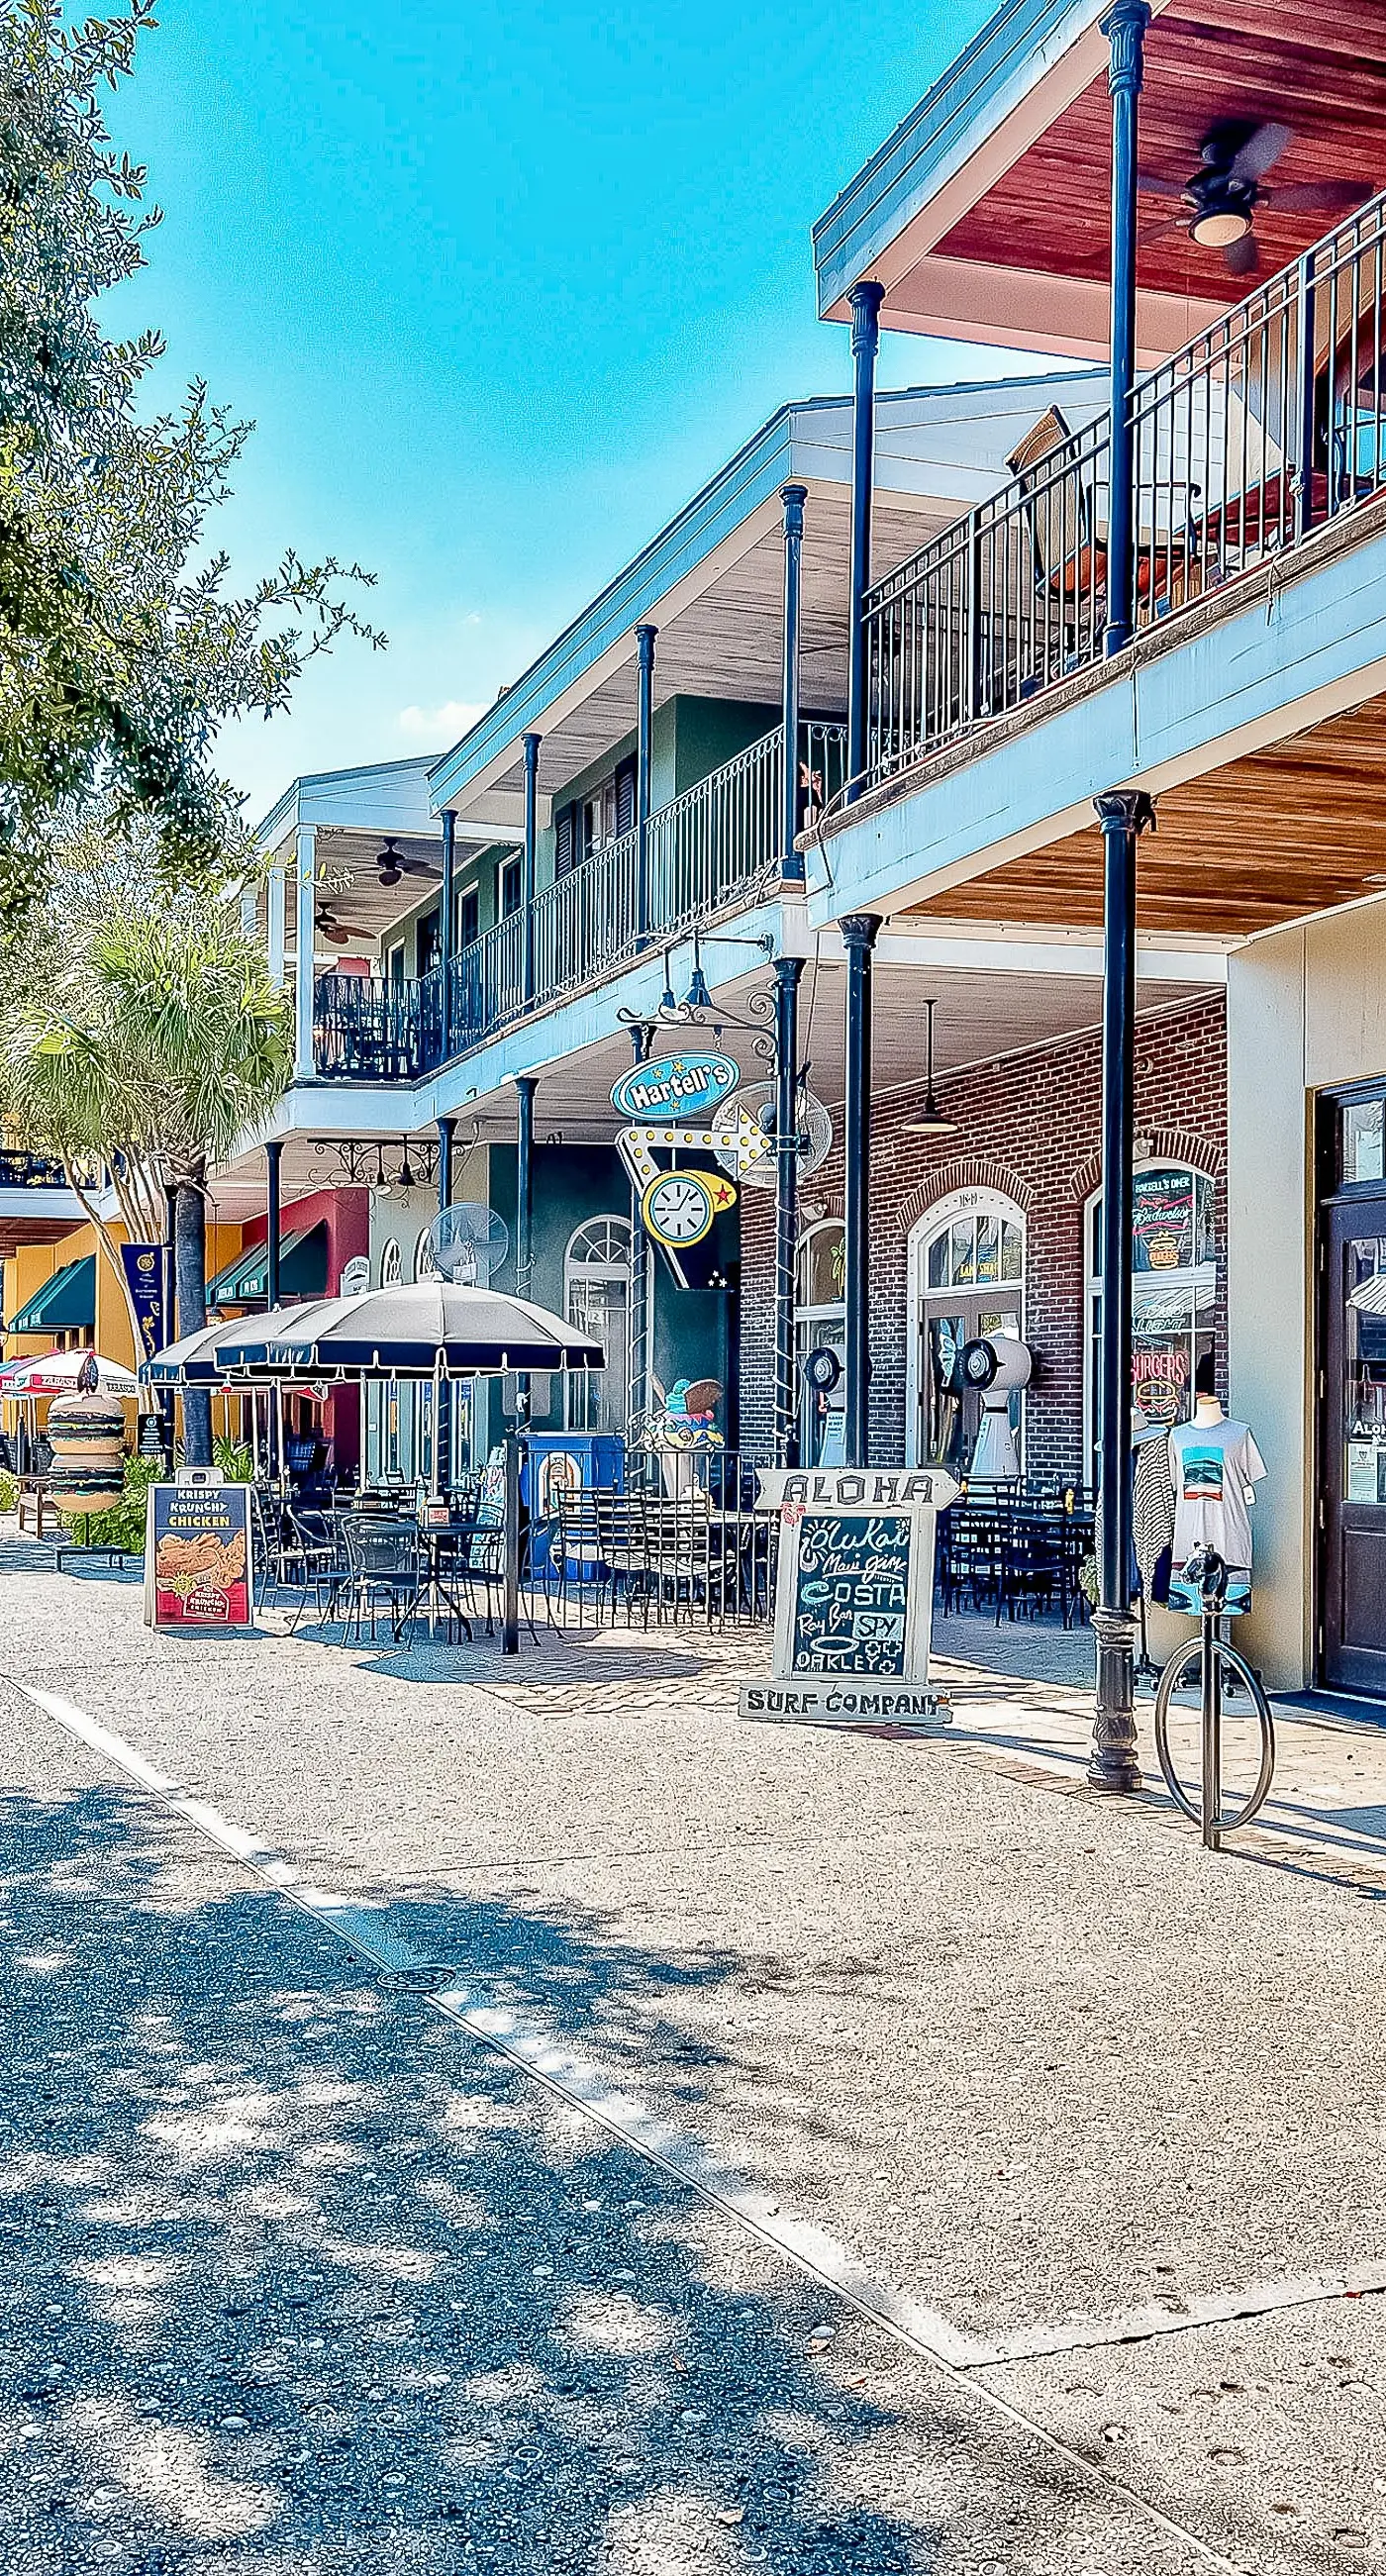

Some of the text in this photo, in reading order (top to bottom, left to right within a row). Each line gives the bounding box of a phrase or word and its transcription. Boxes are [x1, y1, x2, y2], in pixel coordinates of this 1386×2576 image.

[630, 1064, 730, 1111] Hartell's
[177, 1490, 220, 1500] KRISPY
[781, 1475, 934, 1504] ALOHA
[169, 1502, 229, 1514] KRUNCHY
[168, 1516, 230, 1528] CHICKEN
[801, 1581, 906, 1608] COSTA
[857, 1615, 899, 1637] SPY
[796, 1652, 880, 1671] OAKLEY
[746, 1689, 940, 1717] SURF COMPANY
